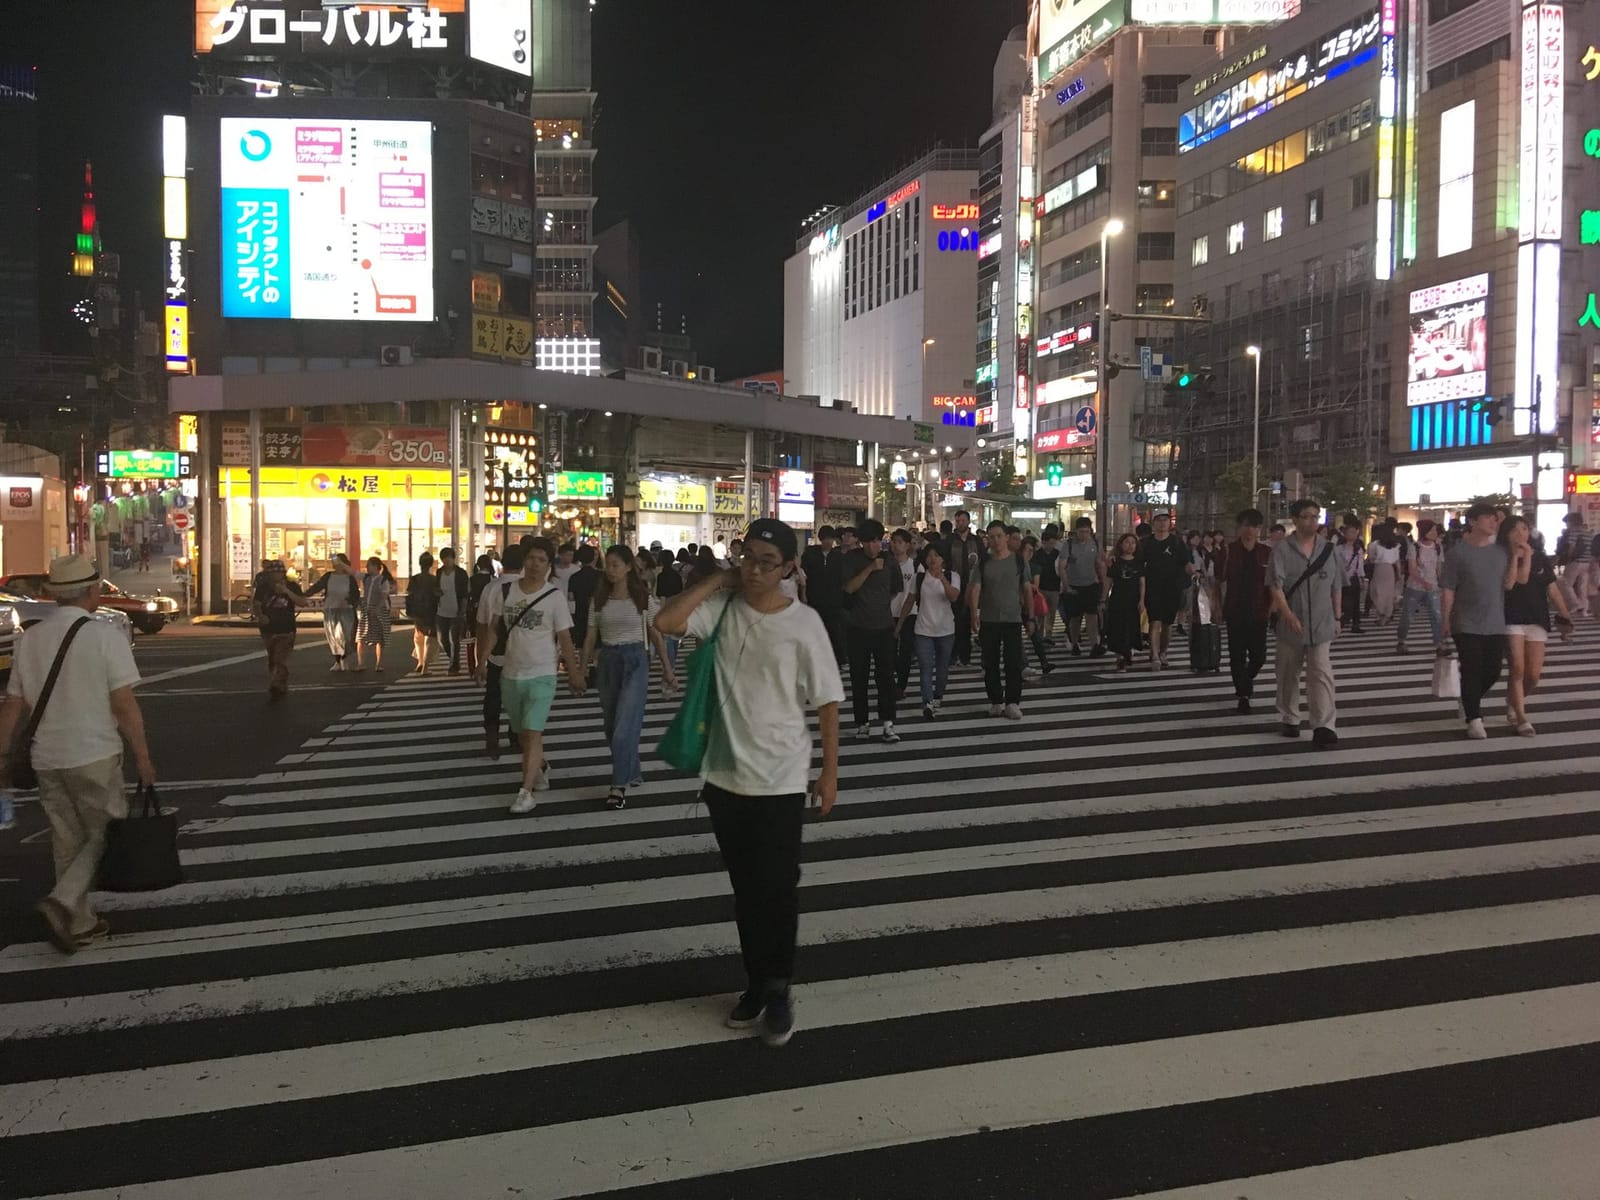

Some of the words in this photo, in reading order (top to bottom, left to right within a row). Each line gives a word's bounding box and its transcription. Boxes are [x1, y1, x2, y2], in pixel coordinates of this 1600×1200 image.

[209, 5, 448, 48] グローバル社
[236, 201, 261, 303] アイシティ
[262, 201, 280, 303] コンタクトの
[388, 440, 445, 463] 350円
[338, 475, 379, 493] 松屋
[715, 495, 742, 511] チケット
